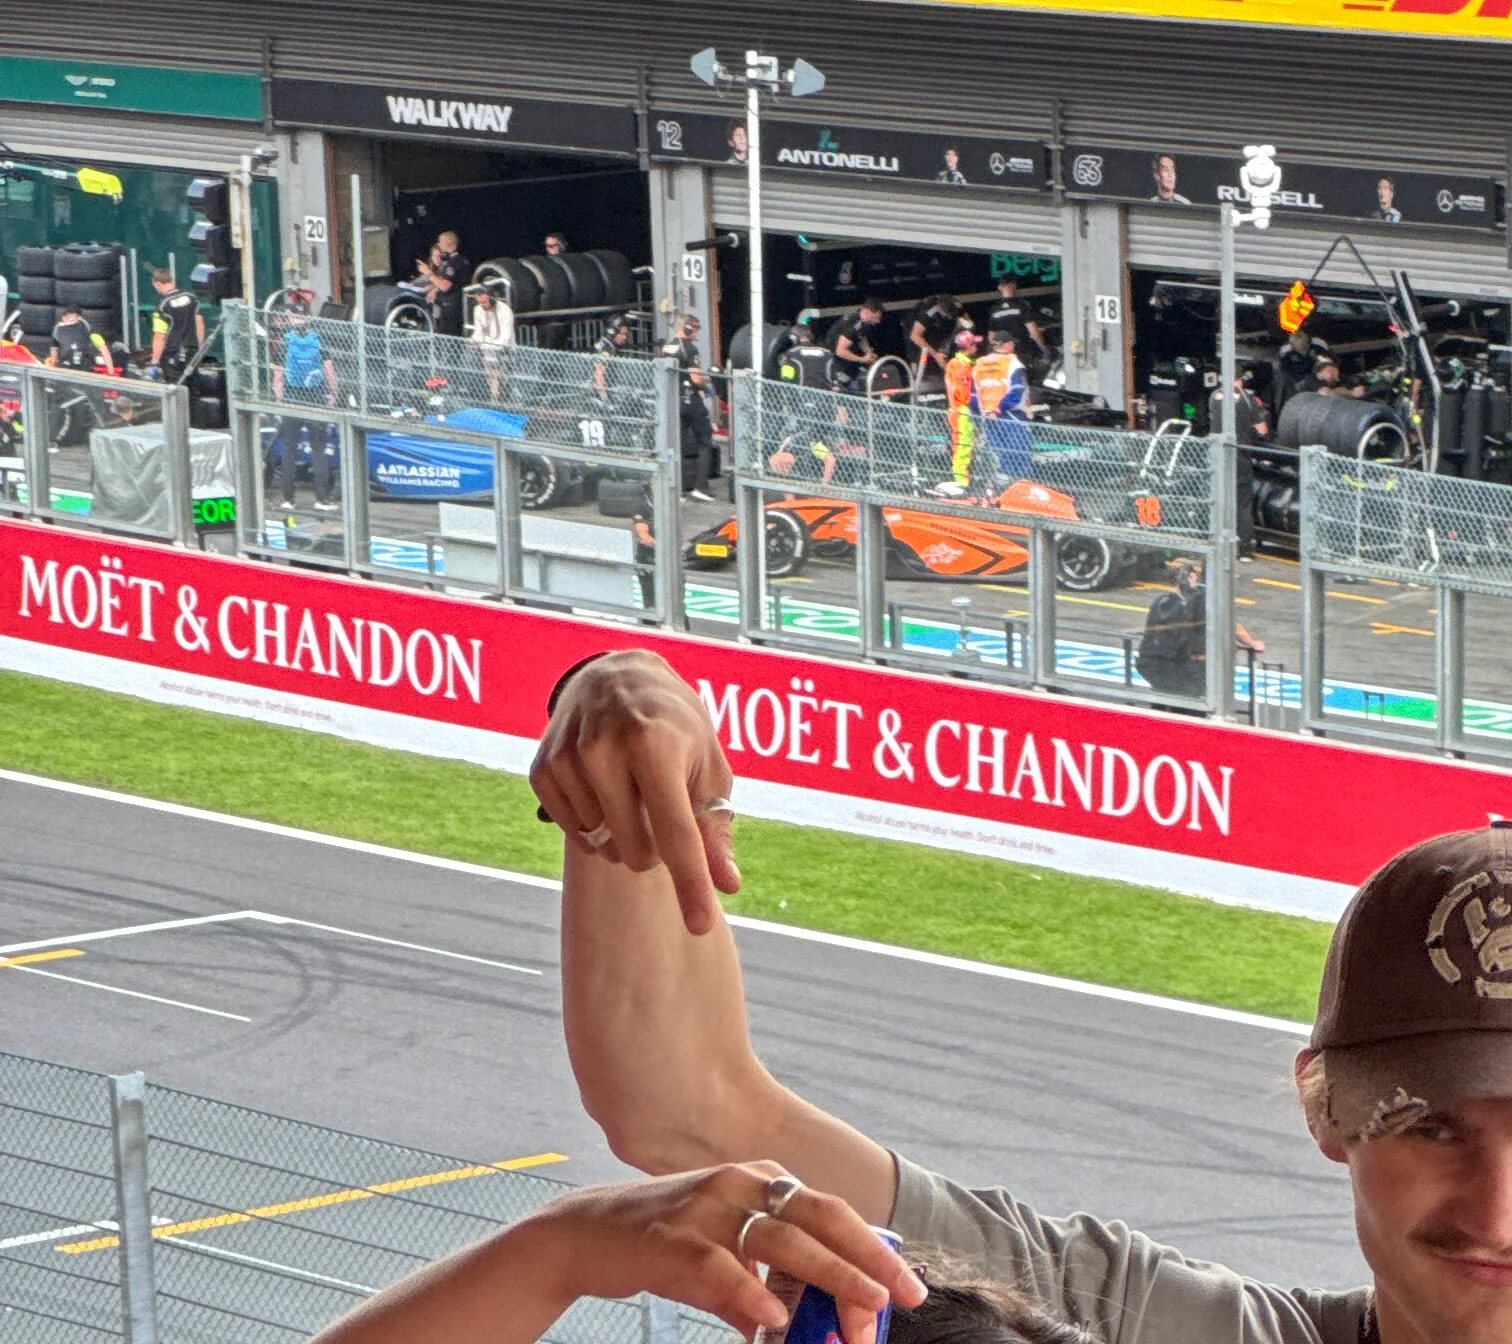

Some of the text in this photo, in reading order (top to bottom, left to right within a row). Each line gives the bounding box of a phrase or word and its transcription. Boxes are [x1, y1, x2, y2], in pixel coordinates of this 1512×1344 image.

[386, 96, 513, 133] WALKWAY
[657, 120, 683, 151] 12
[777, 148, 899, 172] ANTONELLI
[1217, 185, 1323, 209] RUSELL
[306, 219, 325, 239] 20
[684, 256, 704, 281] 19
[1098, 299, 1118, 320] 18
[579, 420, 605, 447] 19
[18, 554, 164, 643] MOËT
[173, 584, 211, 655] &
[217, 595, 484, 704] CHANDON
[696, 677, 863, 771] MOËT
[873, 708, 915, 785] &
[924, 719, 1235, 837] CHANDON
